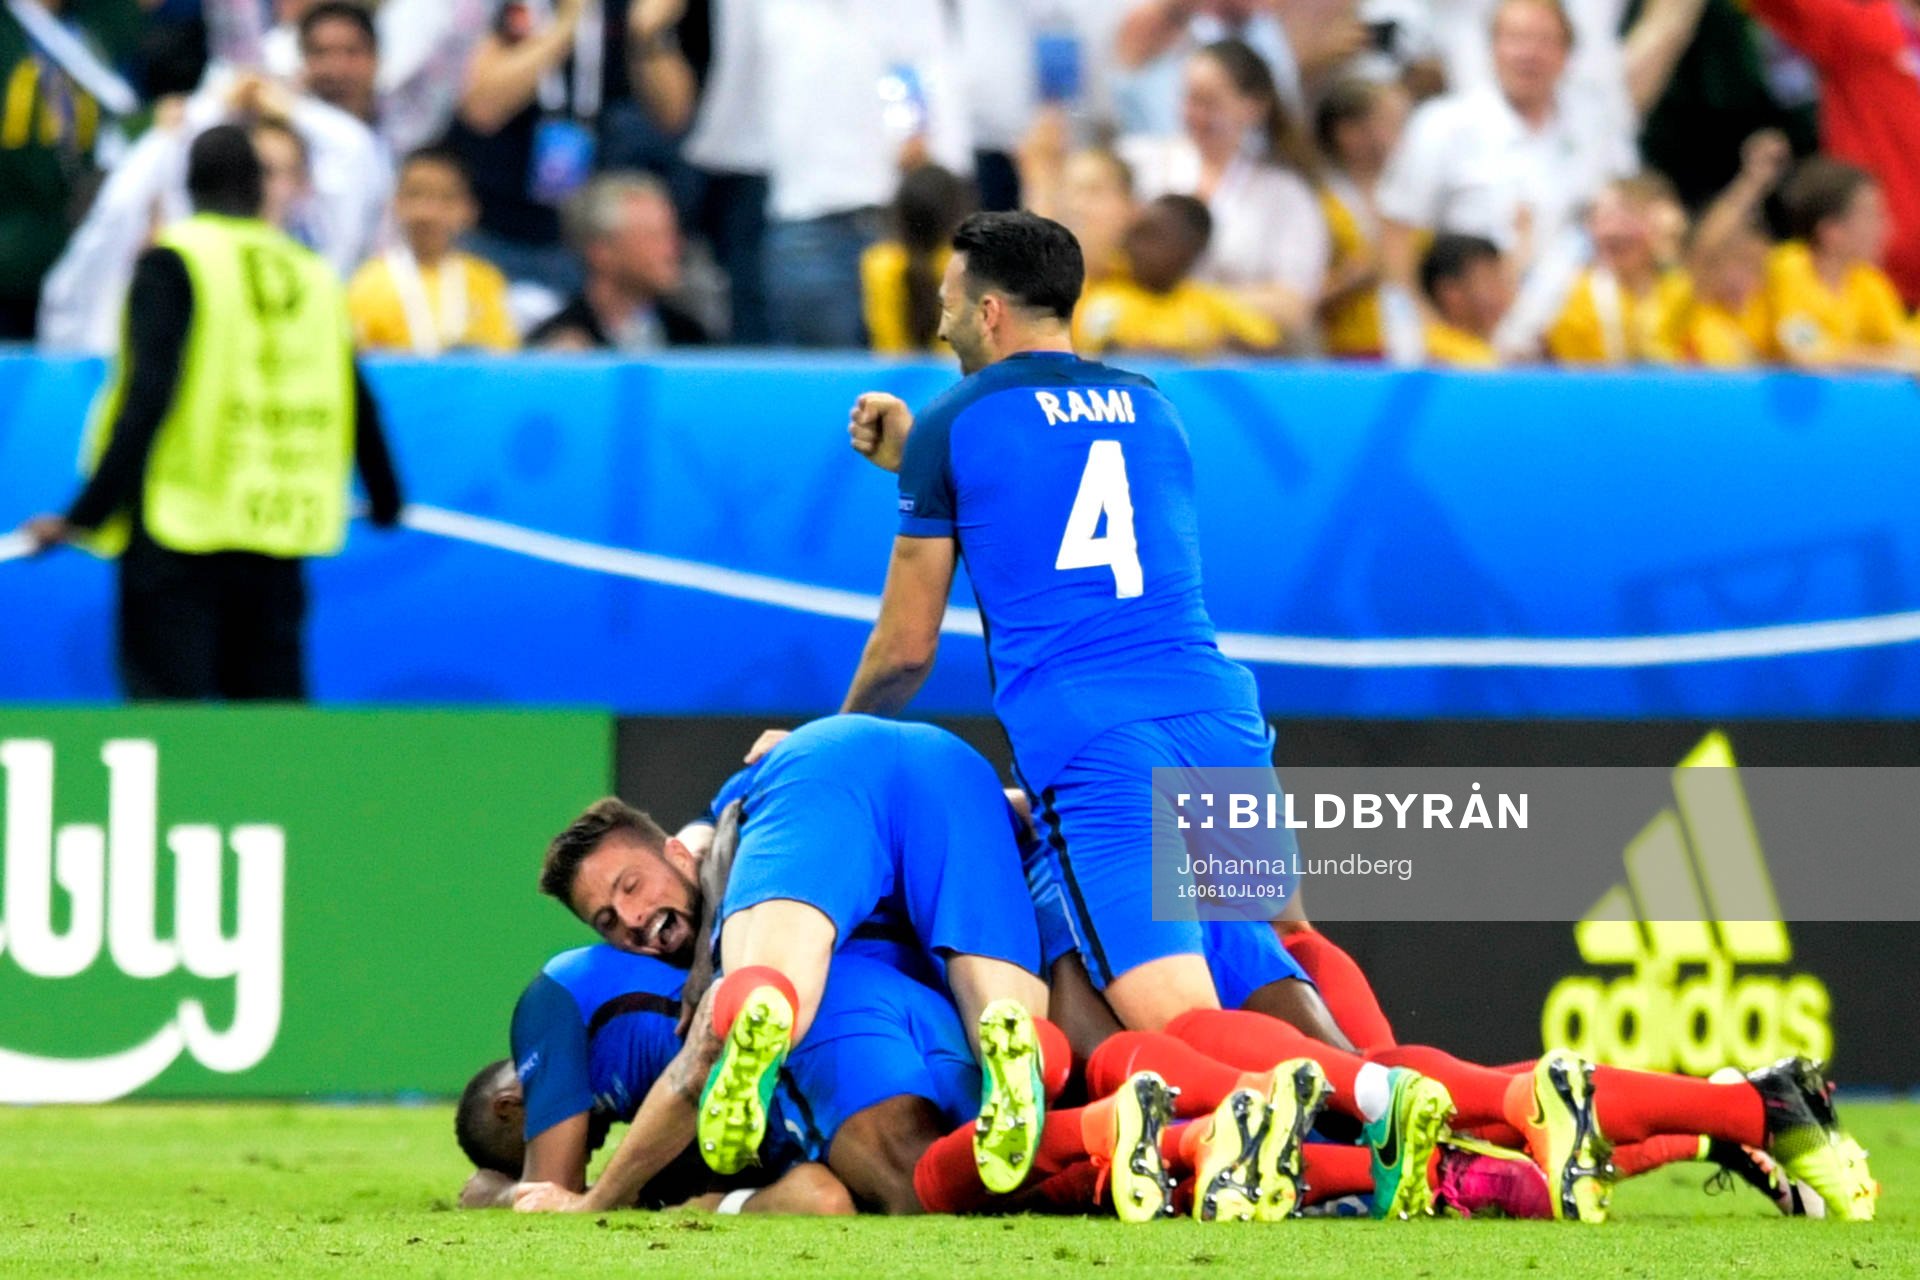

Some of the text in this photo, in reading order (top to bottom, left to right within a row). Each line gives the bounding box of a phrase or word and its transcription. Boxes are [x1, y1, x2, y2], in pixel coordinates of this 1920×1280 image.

[1035, 389, 1136, 426] RAMI
[1055, 439, 1144, 599] 4
[0, 738, 285, 1073] bly
[1541, 958, 1833, 1077] adidas
